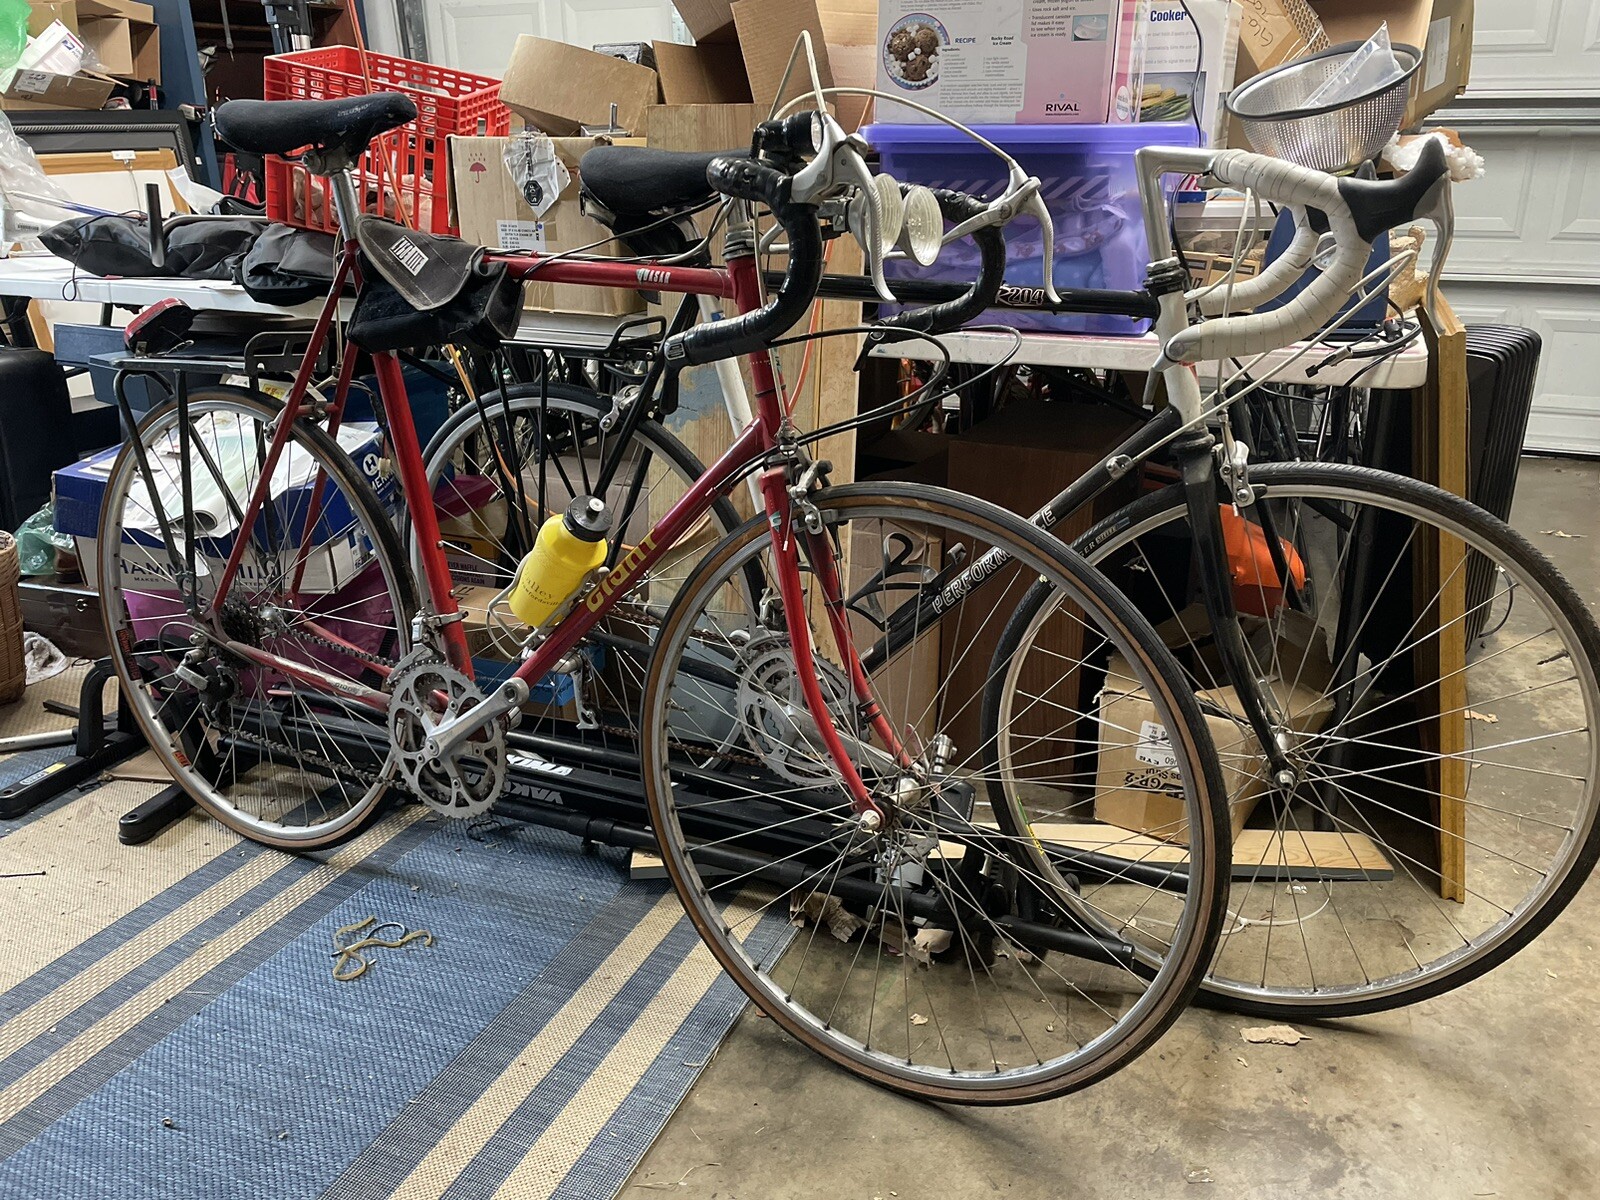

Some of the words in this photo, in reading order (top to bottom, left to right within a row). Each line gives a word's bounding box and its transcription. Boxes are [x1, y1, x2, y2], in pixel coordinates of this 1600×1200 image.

[1150, 10, 1187, 21] Cooker
[1046, 103, 1079, 112] RIVAL
[636, 267, 671, 285] QUASAR
[995, 285, 1045, 306] R204
[932, 505, 1056, 614] PERFORMCE
